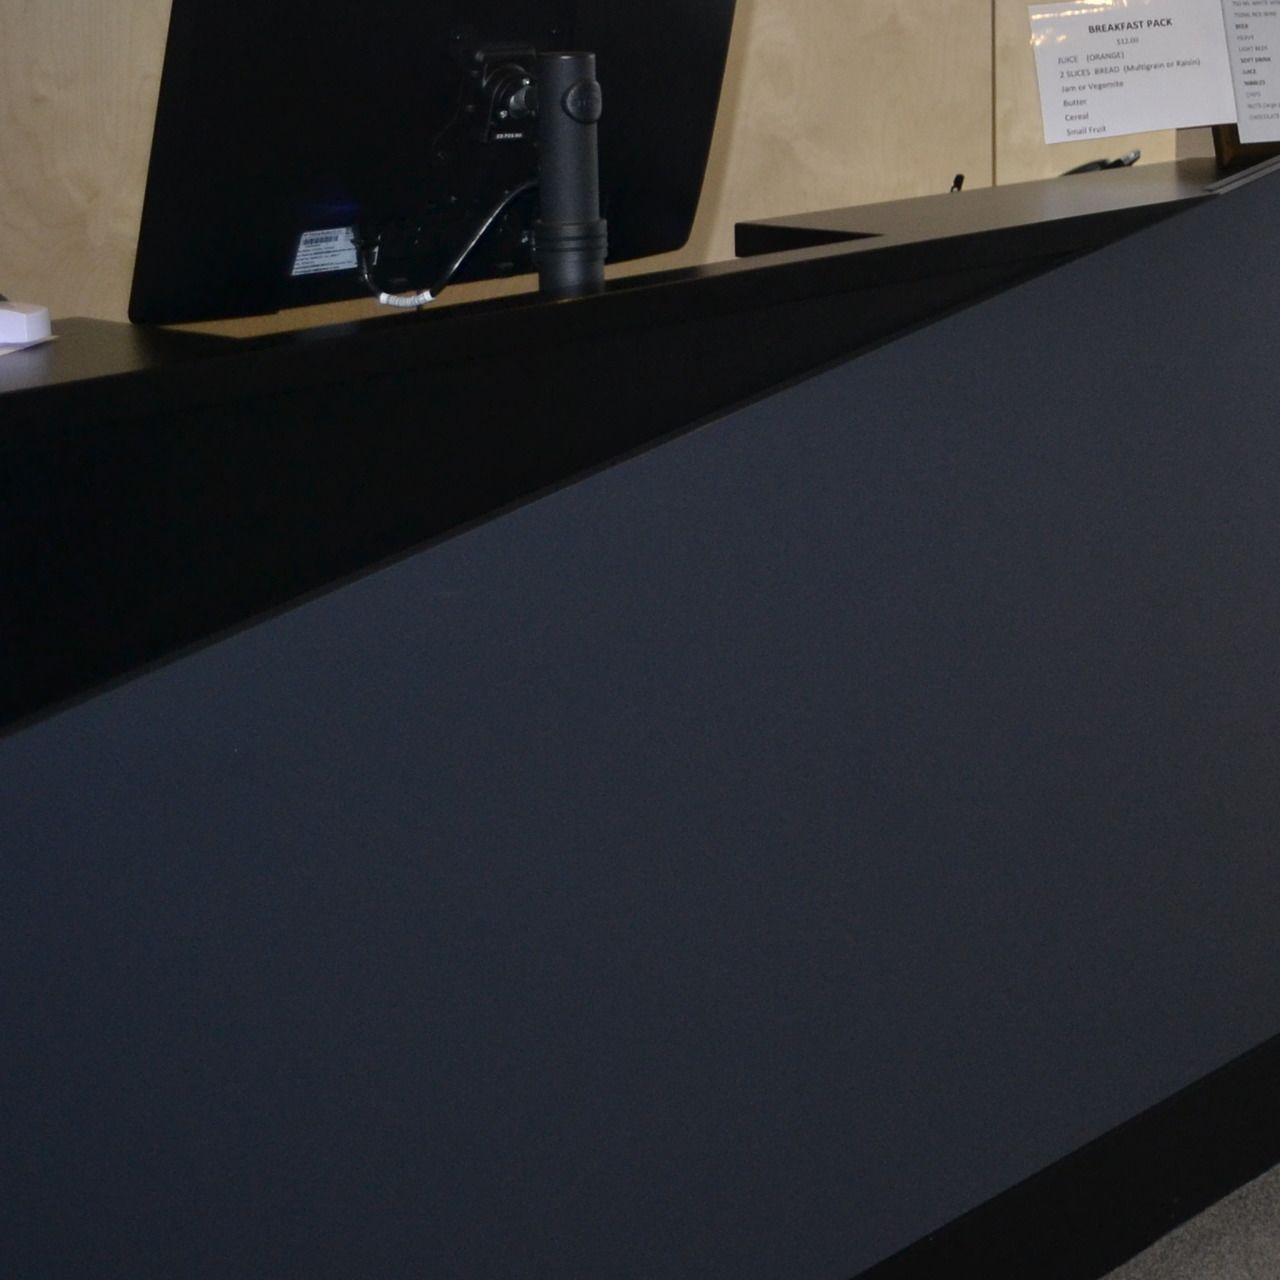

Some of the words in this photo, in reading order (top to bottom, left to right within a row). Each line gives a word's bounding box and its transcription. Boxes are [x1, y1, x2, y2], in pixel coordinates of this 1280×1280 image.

[1088, 20, 1144, 34] BREAKFAST
[1147, 18, 1173, 29] PACK
[1066, 68, 1091, 79] SLICES
[1094, 65, 1120, 76] BREAD
[1062, 86, 1077, 94] Jam
[1088, 80, 1124, 91] Vegemite
[1063, 98, 1087, 108] Butter
[1065, 112, 1089, 122] Cereal
[1066, 126, 1088, 137] Small
[1088, 125, 1107, 135] Fruit
